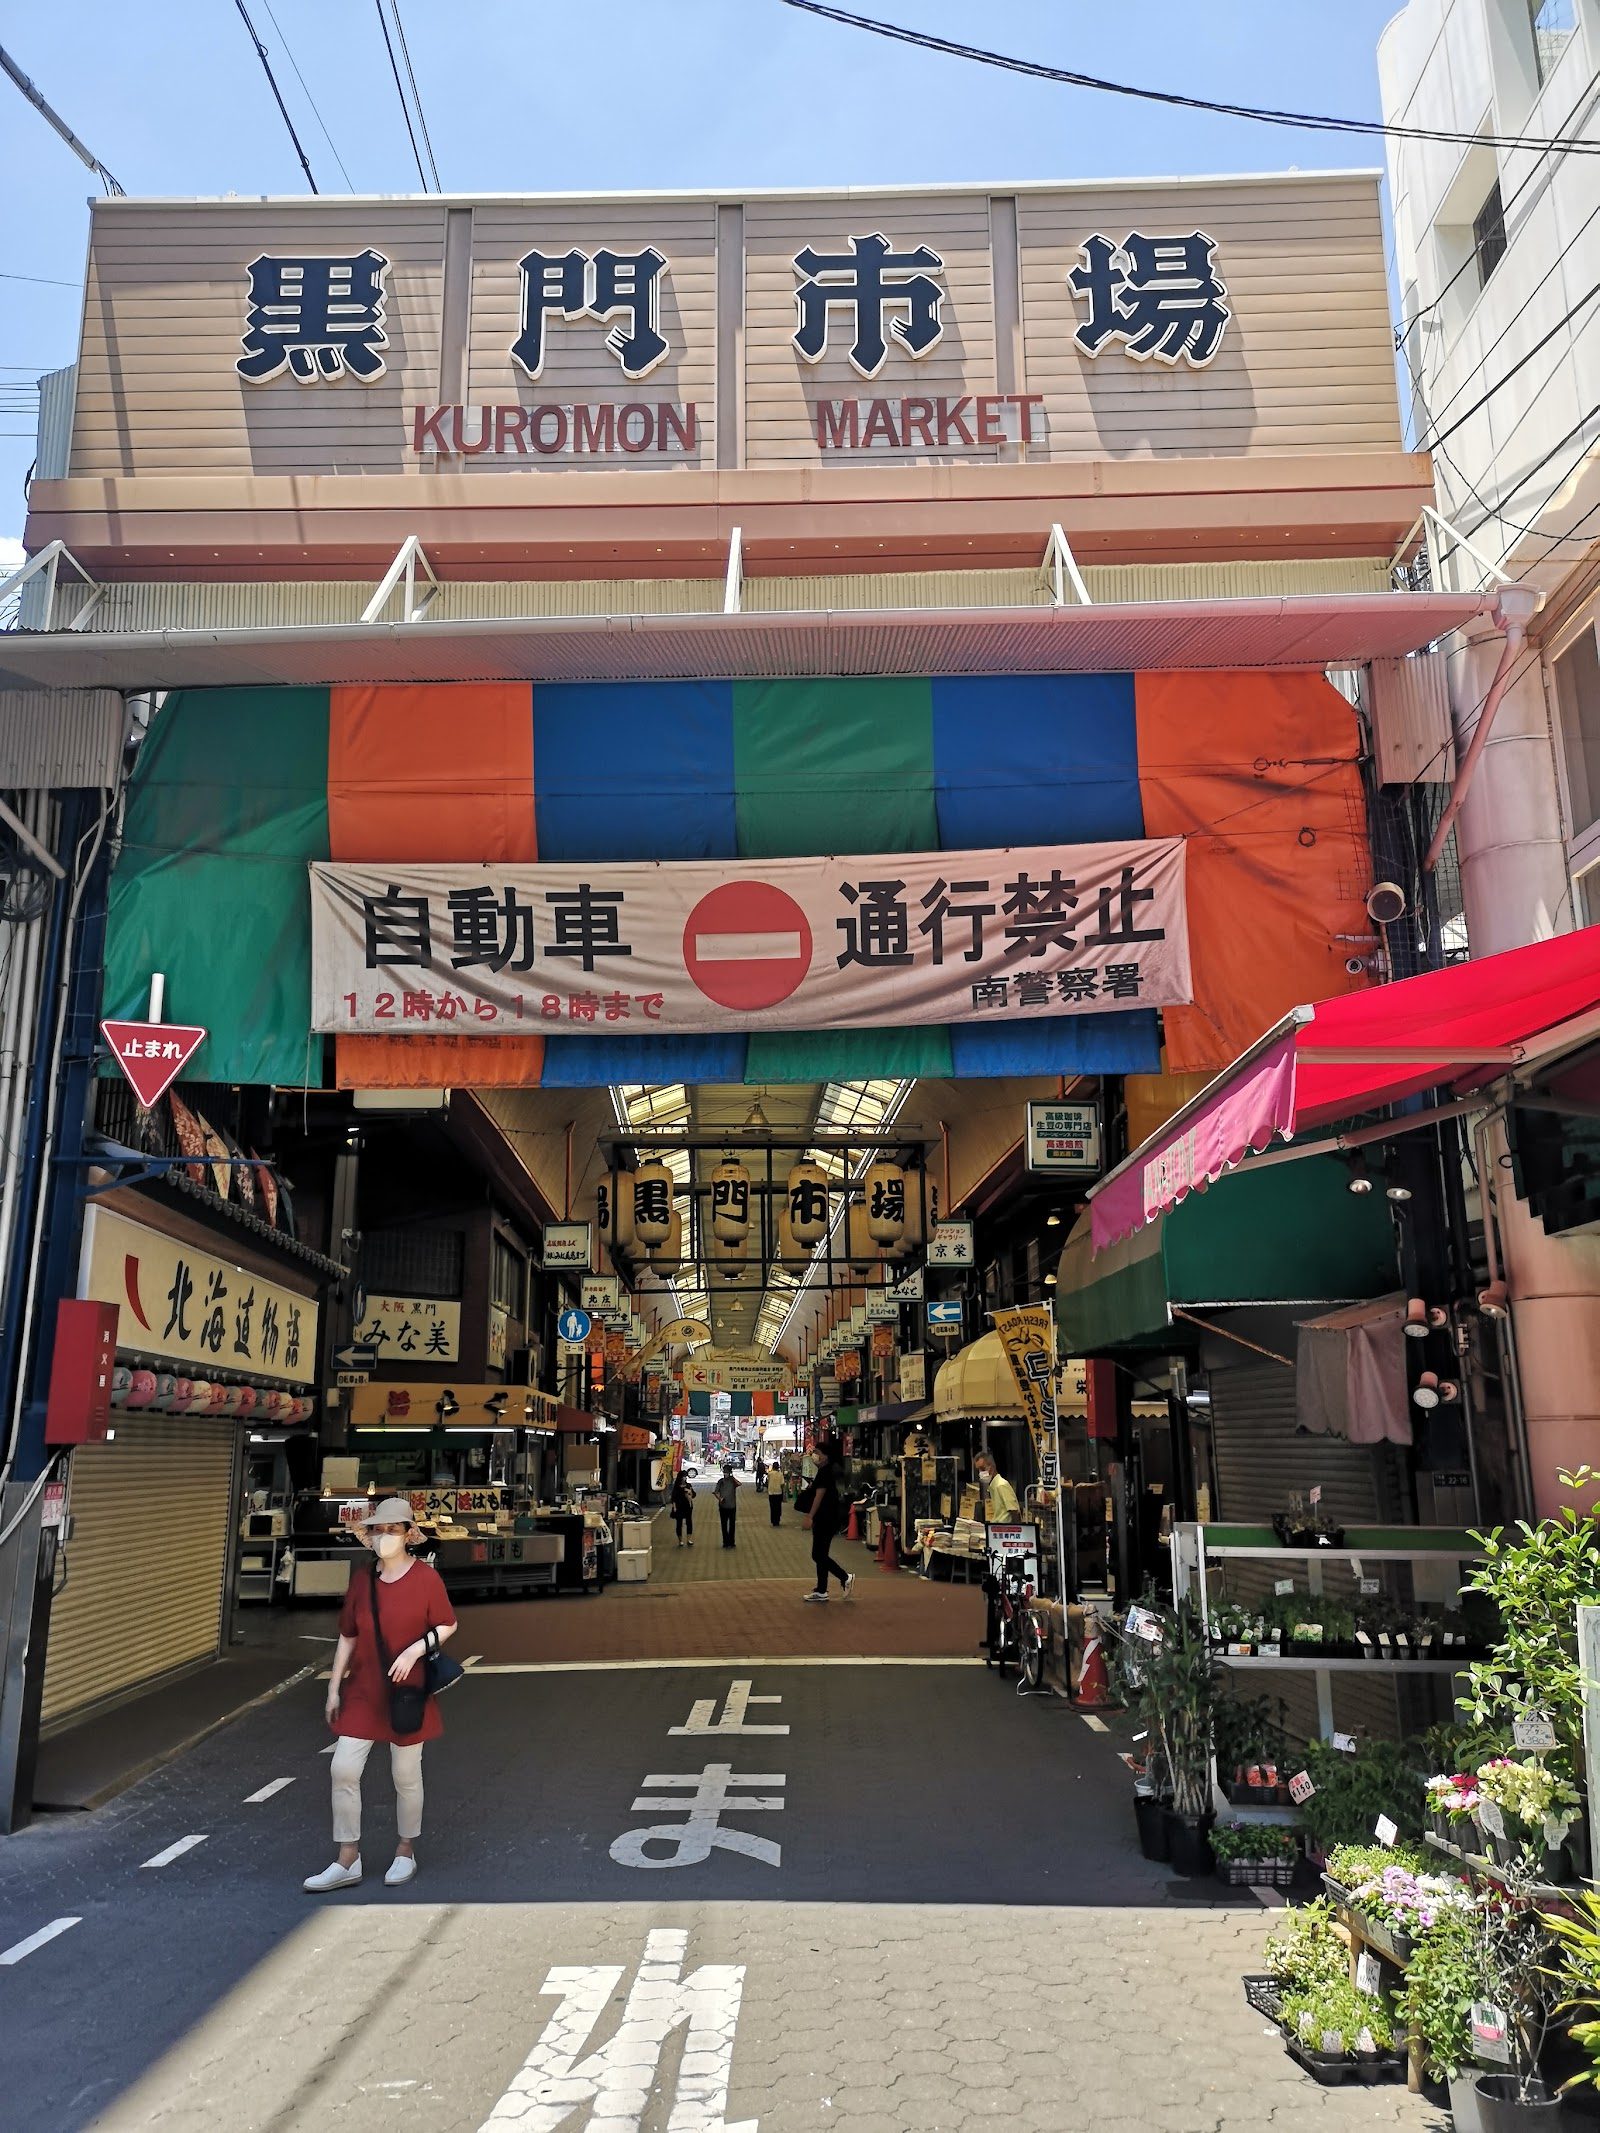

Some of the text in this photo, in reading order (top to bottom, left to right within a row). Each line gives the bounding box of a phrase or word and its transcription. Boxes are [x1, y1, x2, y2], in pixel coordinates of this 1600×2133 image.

[235, 230, 1232, 385] 黒門市場
[413, 394, 1044, 454] KUROMON MARKET
[362, 866, 1166, 974] 自動車 通行禁止
[970, 961, 1145, 1010] 南警察署
[122, 1038, 183, 1061] 止まれ
[1036, 1121, 1091, 1131] 生豆の専門店
[634, 1178, 905, 1225] 黒門市場
[934, 1244, 967, 1258] 京栄
[163, 1259, 300, 1369] 北海道物語
[363, 1319, 450, 1356] みな美
